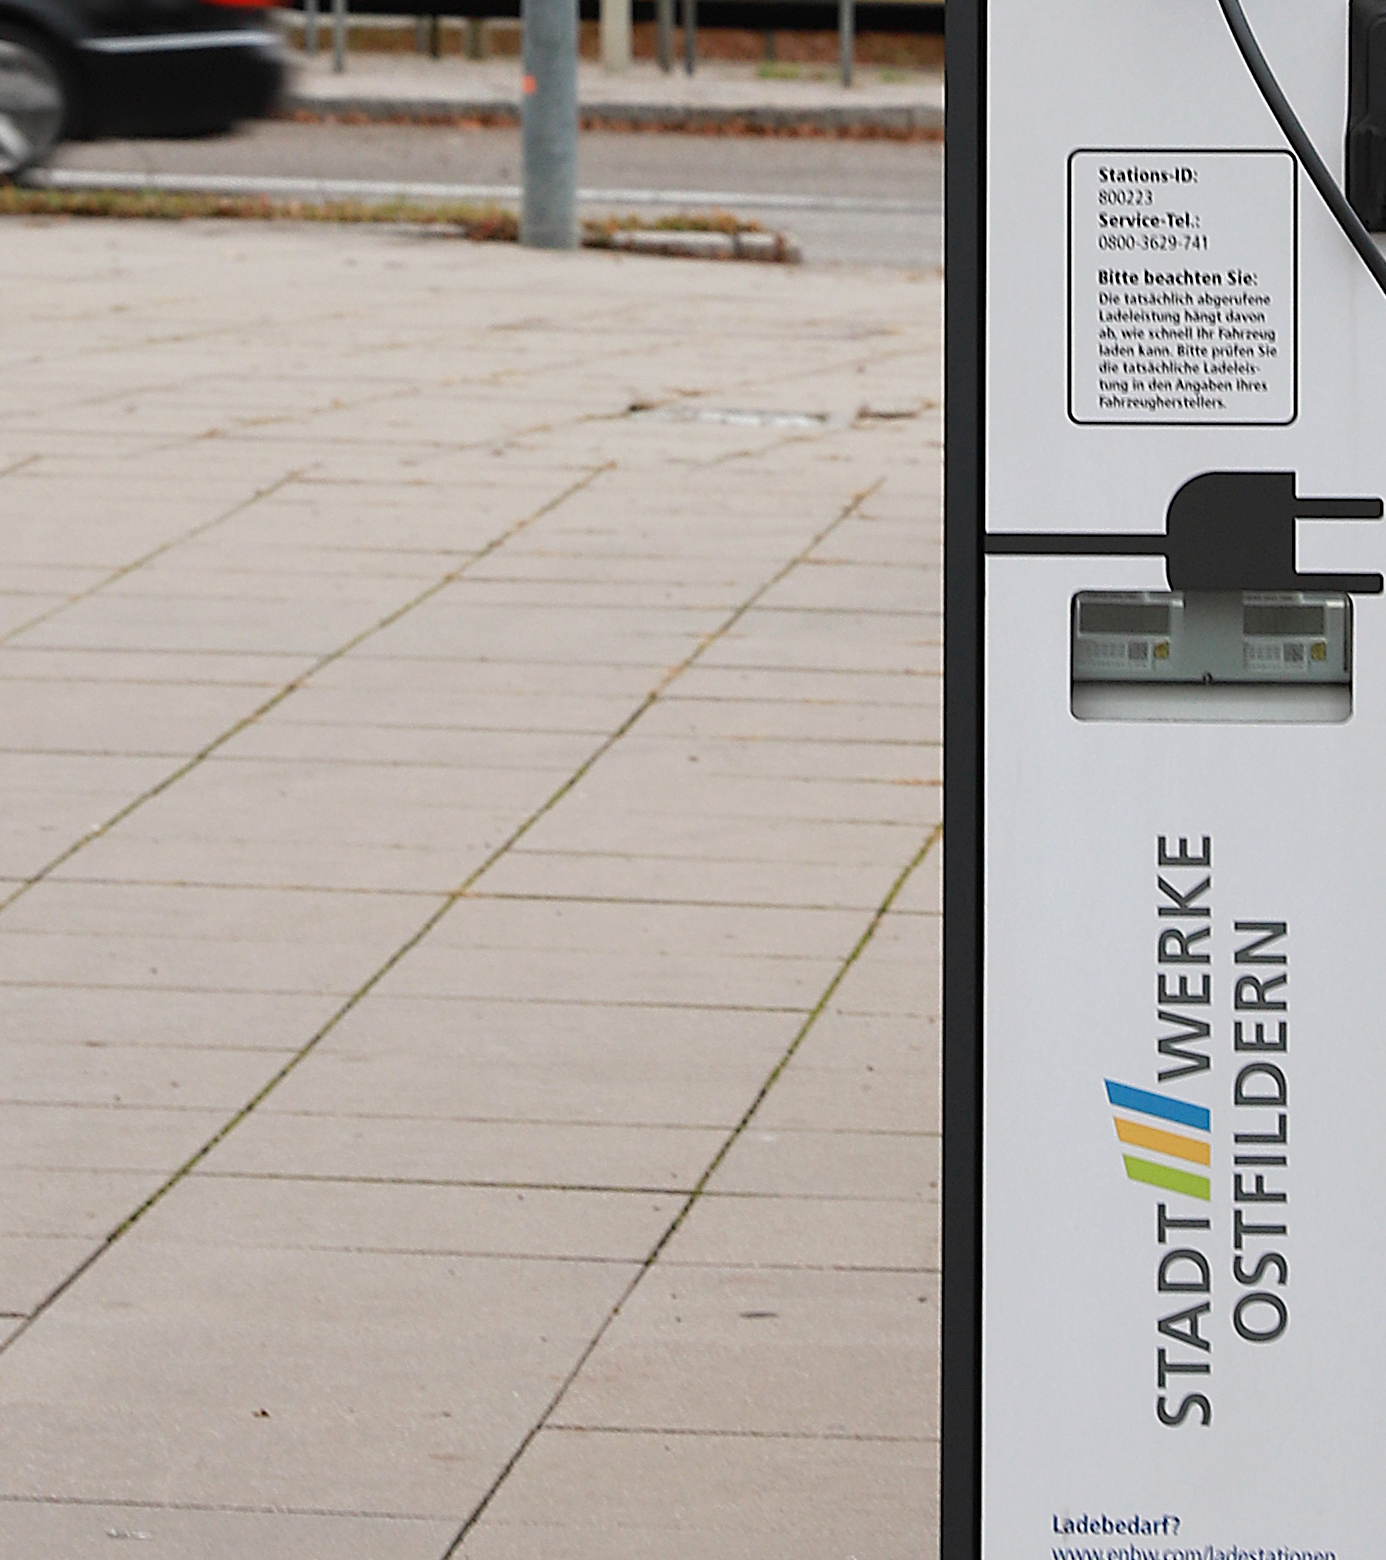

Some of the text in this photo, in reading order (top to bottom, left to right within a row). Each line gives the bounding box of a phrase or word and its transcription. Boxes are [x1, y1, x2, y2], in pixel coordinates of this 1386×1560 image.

[1099, 166, 1198, 183] Stations-ID:
[1099, 190, 1153, 205] 800223
[1099, 212, 1200, 228] Service-Tel.:
[1099, 235, 1208, 250] 0800-3629-741
[1099, 269, 1257, 285] Bitte beachten Sie:
[1099, 292, 1270, 308] Die tatsächlich abgerufene
[1099, 310, 1265, 325] Ladeleistung hängt davon
[1121, 327, 1144, 339] wie
[1149, 327, 1192, 339] schnell
[1197, 327, 1213, 339] Ihr
[1219, 327, 1275, 342] Fahrzeug
[1099, 344, 1277, 360] laden kann. Bitte prüfen Sie
[1099, 361, 1261, 374] die tatsächliche Ladeleis-
[1099, 378, 1267, 395] tung in den Angaben Ihres
[1099, 395, 1226, 411] Fahrzeugherstellers.
[1157, 835, 1211, 1427] STADT WERKE
[1234, 921, 1288, 1342] OSTFILDERN
[1053, 1514, 1180, 1536] Ladebedarf?
